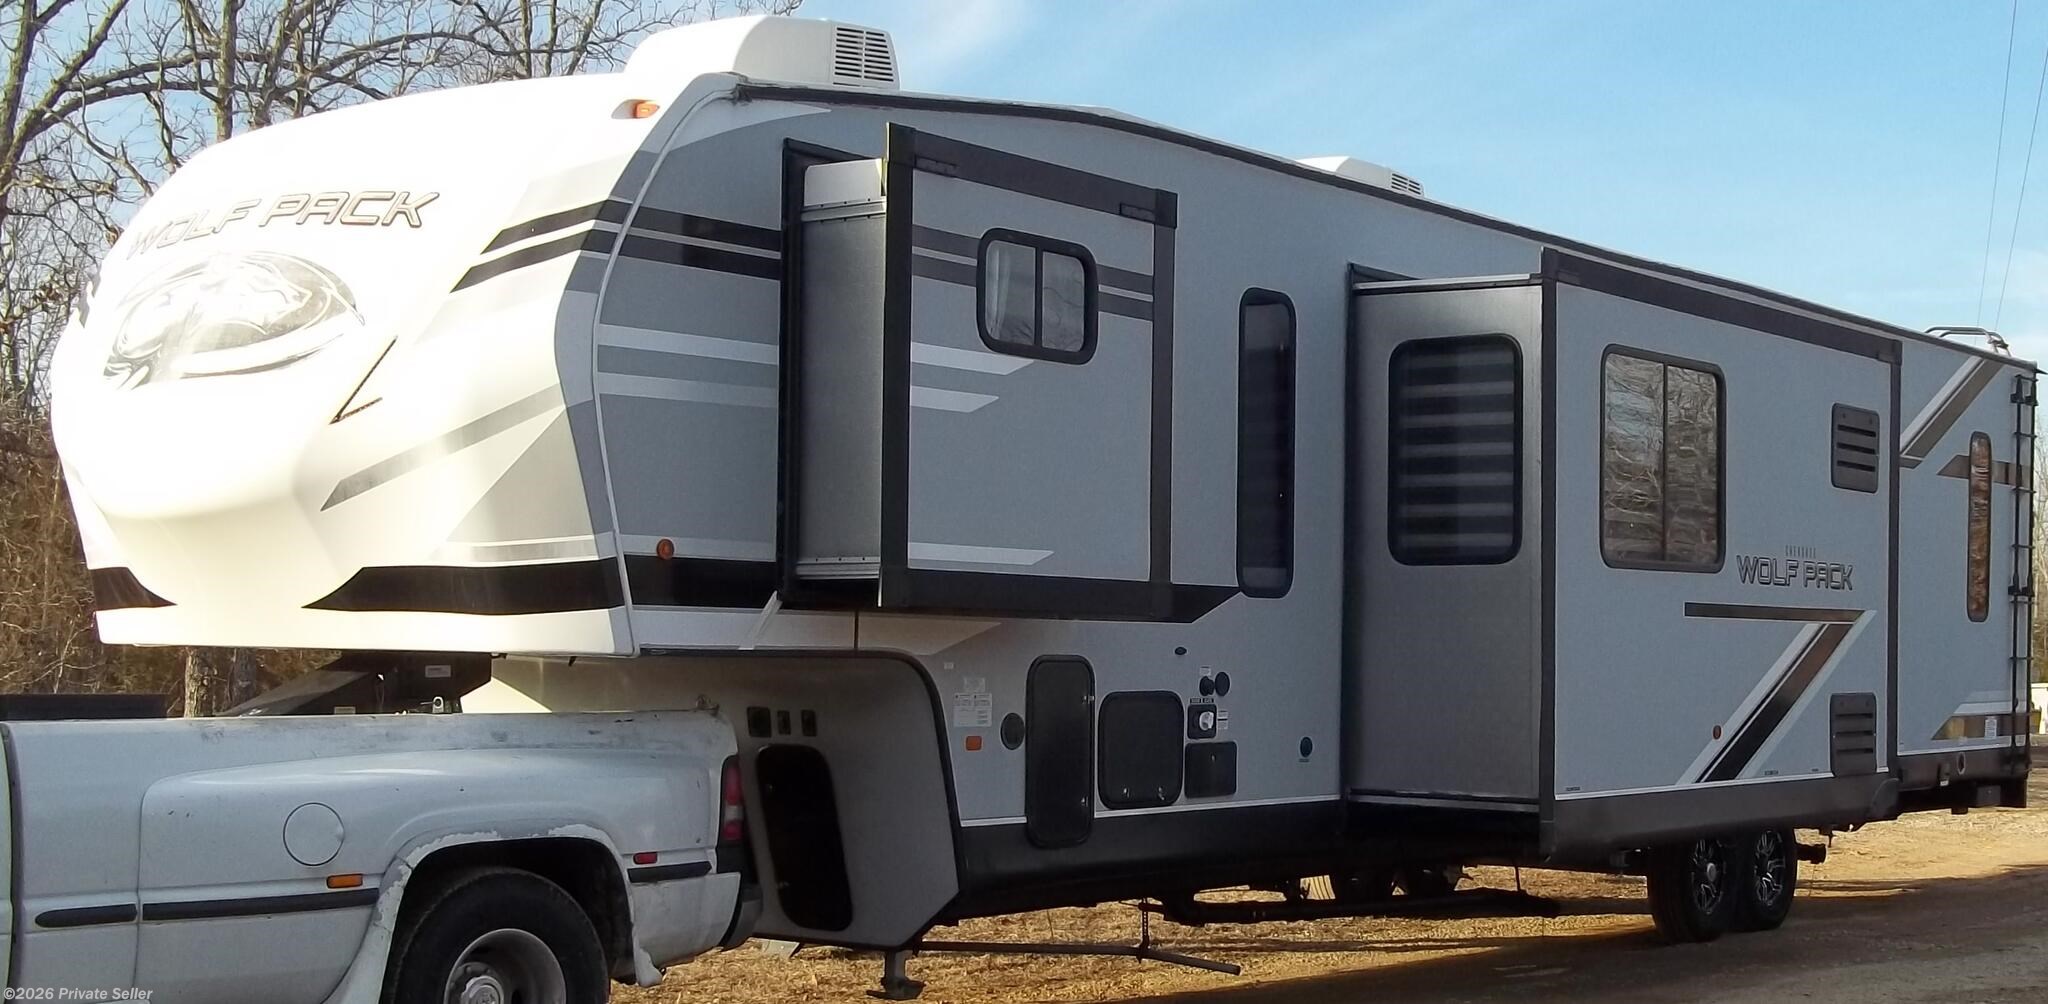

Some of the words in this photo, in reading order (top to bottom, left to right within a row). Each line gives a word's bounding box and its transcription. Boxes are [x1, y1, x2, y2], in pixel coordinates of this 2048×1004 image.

[126, 199, 262, 260] WOLF
[259, 190, 440, 228] PACK
[1736, 555, 1799, 587] WOLF
[1803, 560, 1853, 591] PACK
